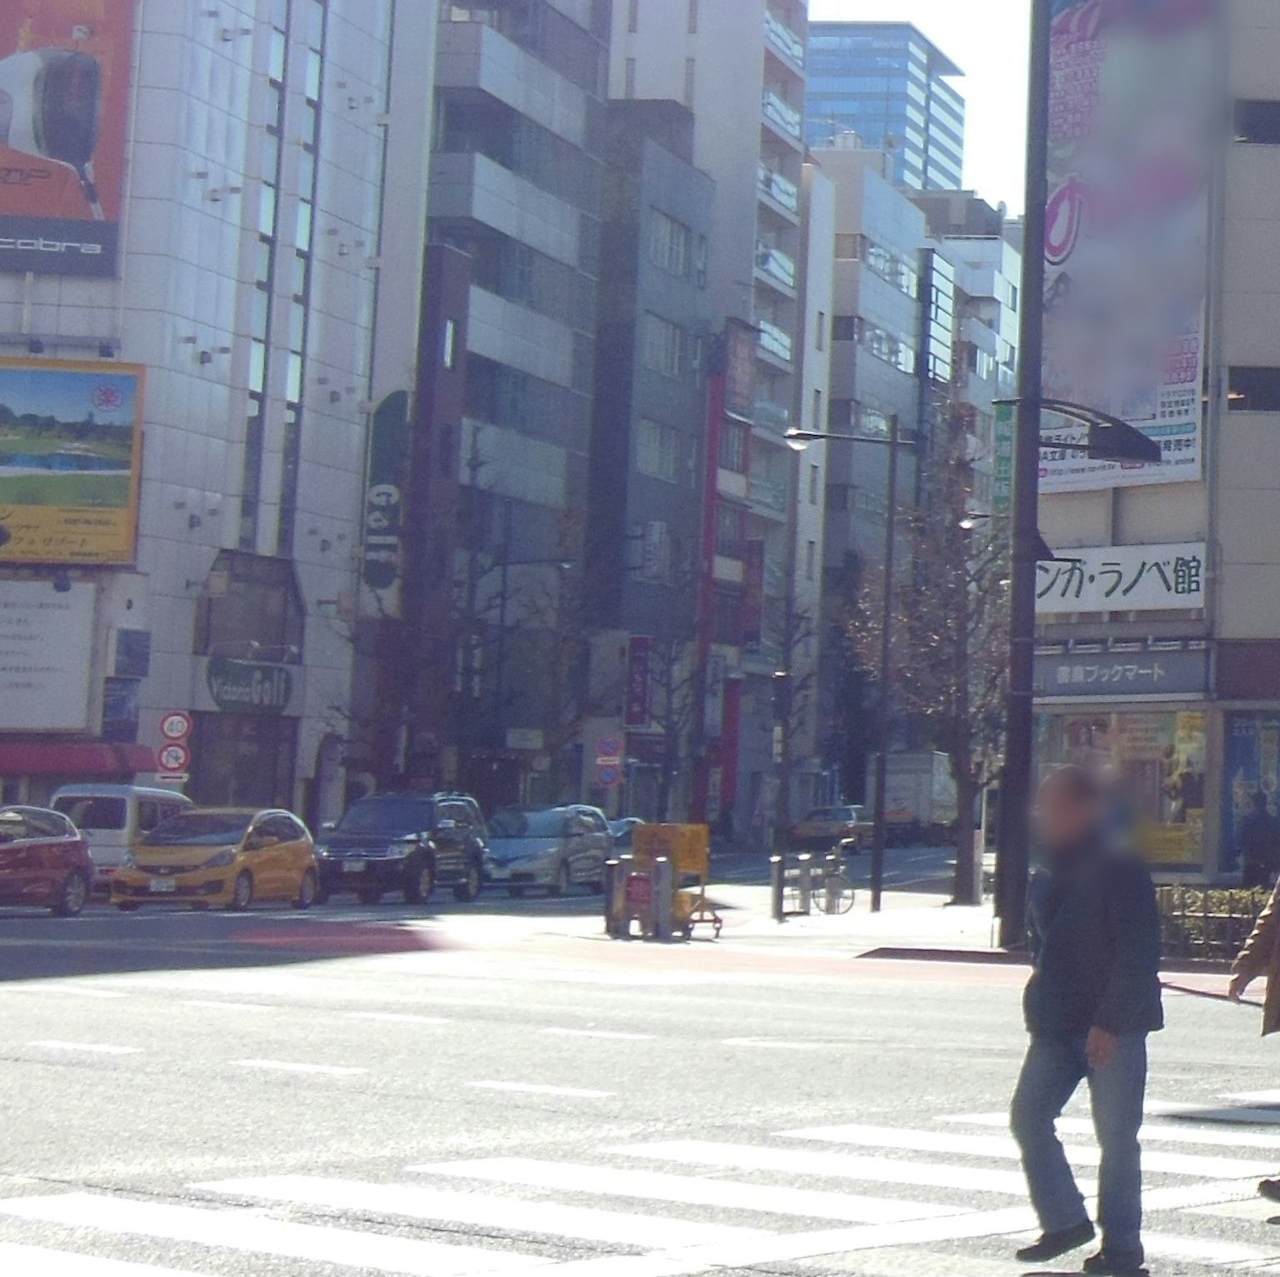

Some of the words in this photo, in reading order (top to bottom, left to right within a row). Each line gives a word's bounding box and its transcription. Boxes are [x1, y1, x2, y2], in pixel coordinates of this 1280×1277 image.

[1056, 662, 1165, 685] 書泉ブックマート
